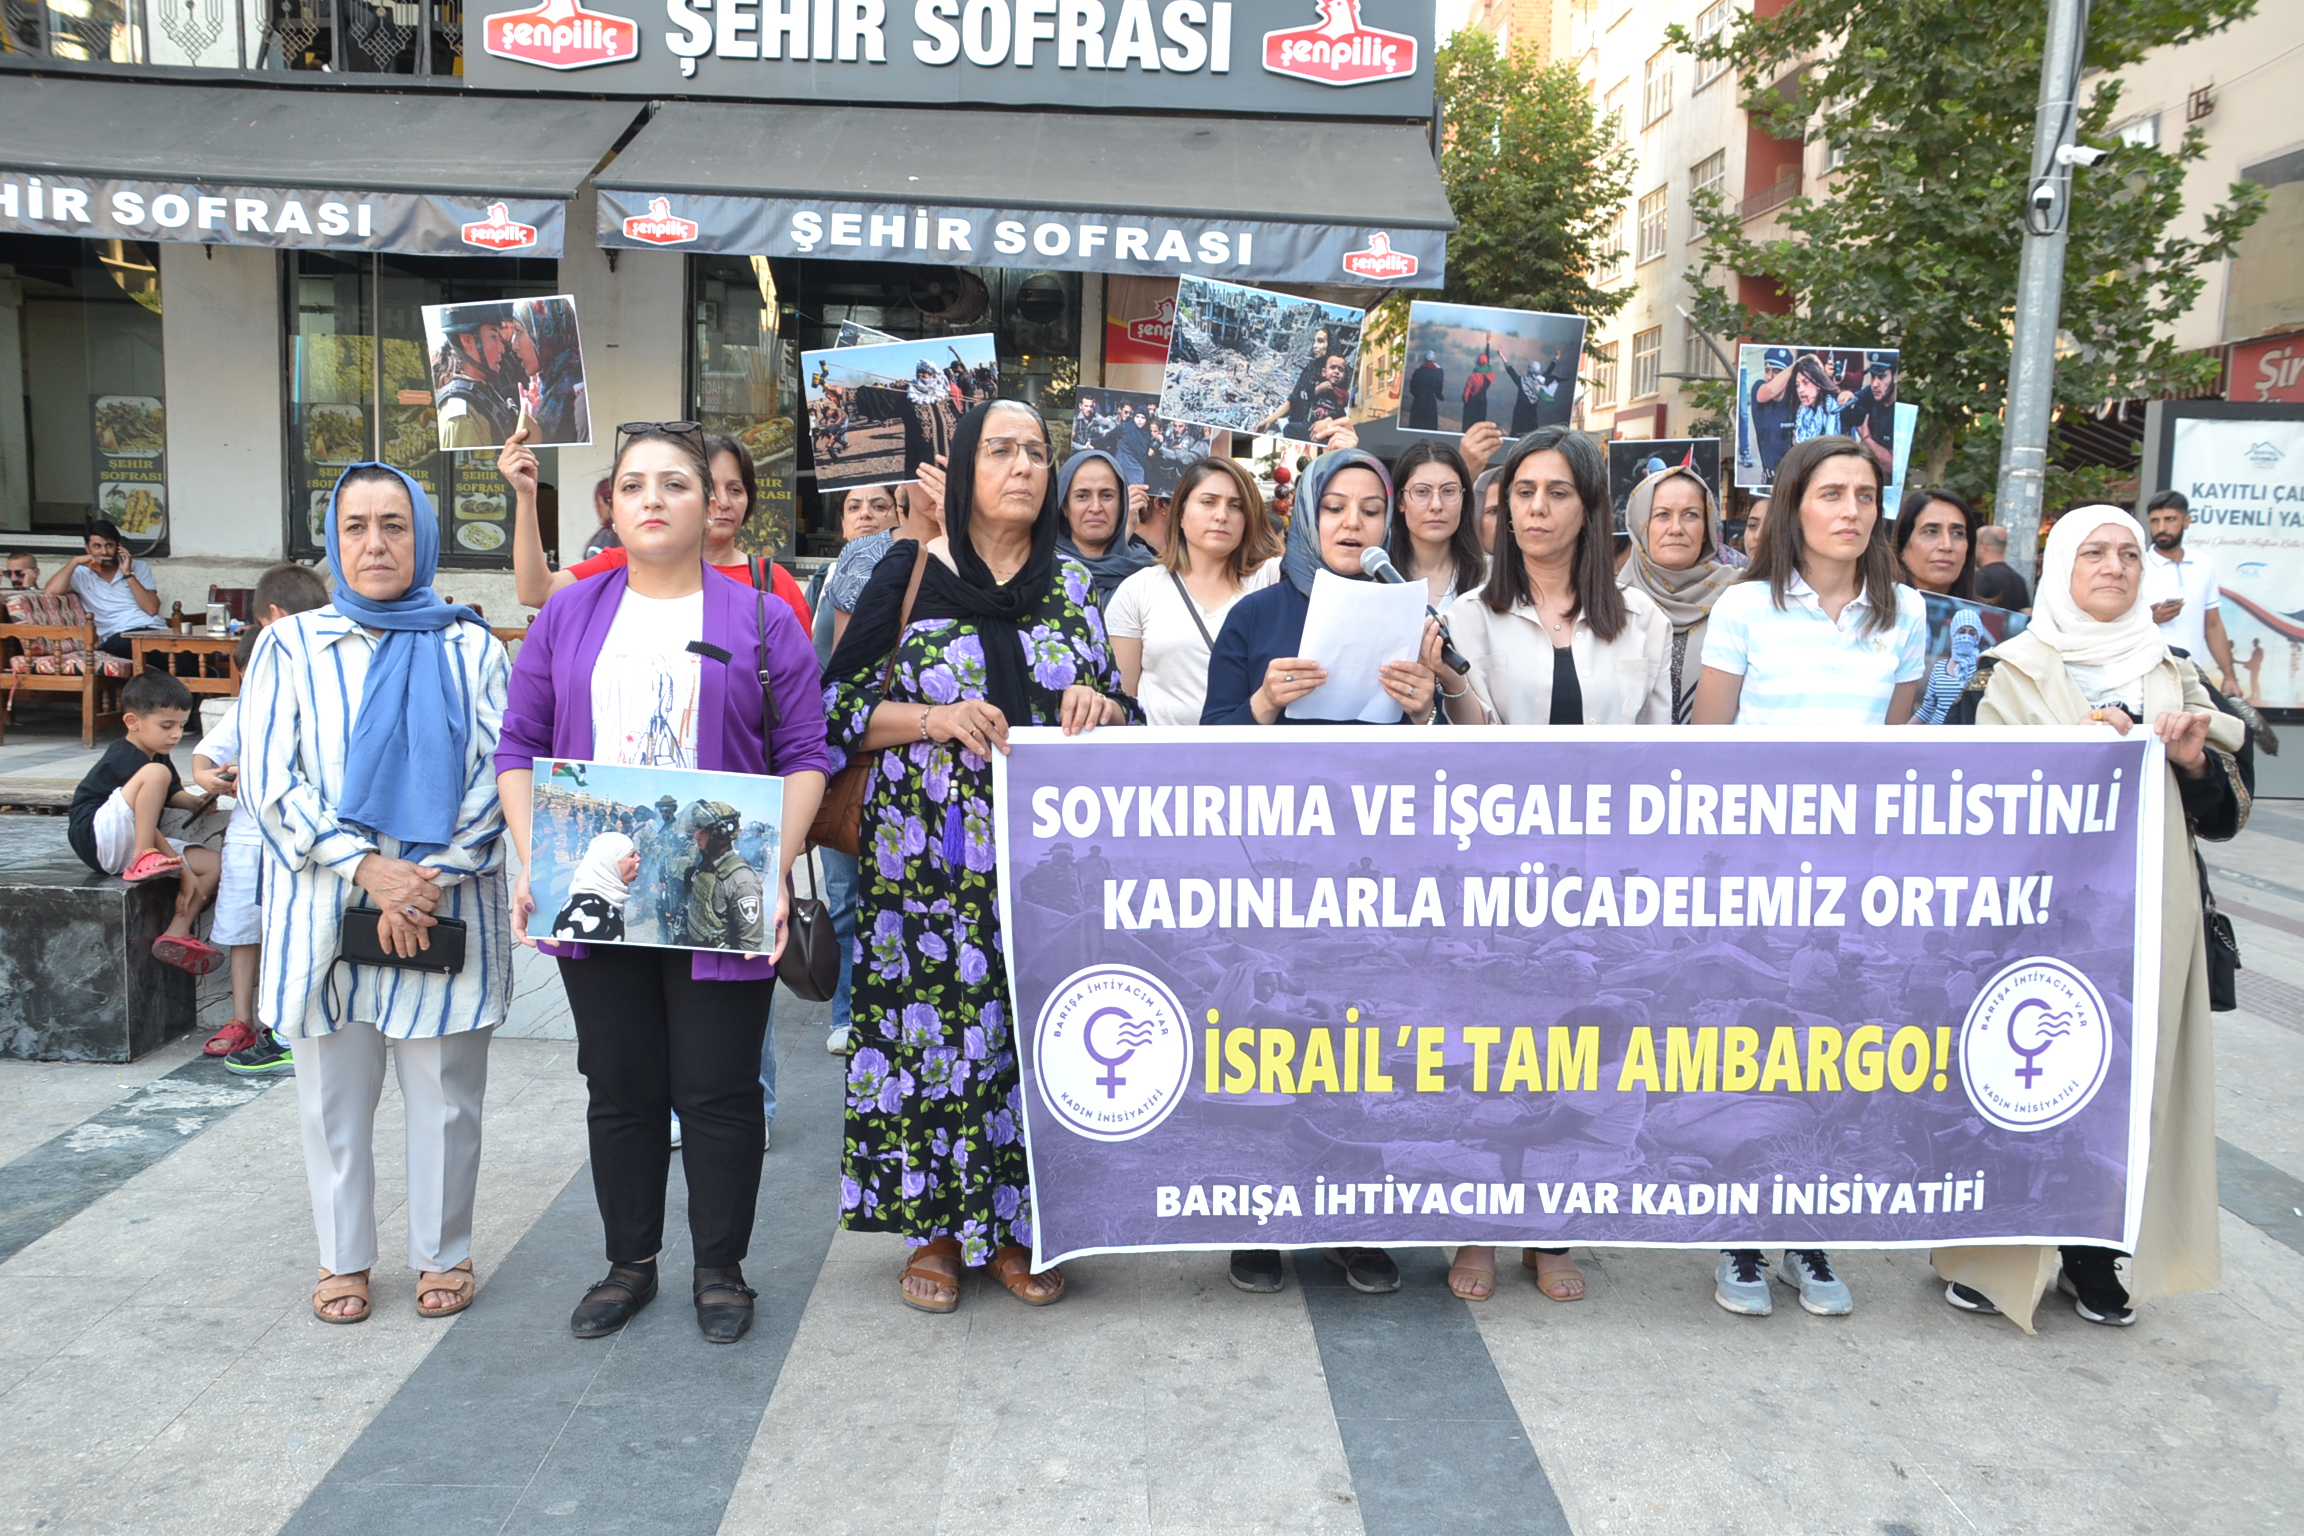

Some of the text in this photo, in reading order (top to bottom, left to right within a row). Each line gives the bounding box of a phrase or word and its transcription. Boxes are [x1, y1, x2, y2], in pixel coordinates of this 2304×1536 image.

[502, 19, 618, 56] şenpiliç
[912, 0, 1231, 73] SOFRASI
[1280, 36, 1397, 74] şenpiliç
[111, 191, 372, 237] SOFRASI
[632, 220, 689, 240] şenpiliç
[470, 223, 528, 246] şenpiliç
[790, 209, 1252, 265] ŞEHİR SOFRASI
[1351, 254, 1409, 274] şenpiliç
[100, 471, 163, 481] SOFRASI
[108, 459, 154, 470] ŞEHİR
[462, 470, 498, 481] ŞEHİR
[456, 483, 505, 493] SOFRASI
[2191, 482, 2268, 501] KAYITLI
[2189, 505, 2273, 527] GÜVENLİ
[1031, 767, 2123, 851] SOYKIRIMA VE İŞGALE DİRENEN FİLİSTİNLİ
[1103, 861, 2054, 930] KADINLARLA MÜCADELEMİZ ORTAK!
[1053, 978, 1169, 1038] BARIŞA İHTİYACIM VAR
[1981, 970, 2088, 1031] BARIŞA İHTİYACIM VAR
[1463, 1026, 1600, 1093] TAM
[1616, 1025, 1952, 1094] AMBARGO!
[1060, 1088, 1164, 1123] KADIN İNİSİYATİFİ
[1982, 1079, 2080, 1114] KADIN İNİSİYATİFİ
[1157, 1169, 1986, 1226] BARIŞA İHTİYACIM VAR KADIN İNİSİYATİFİ
